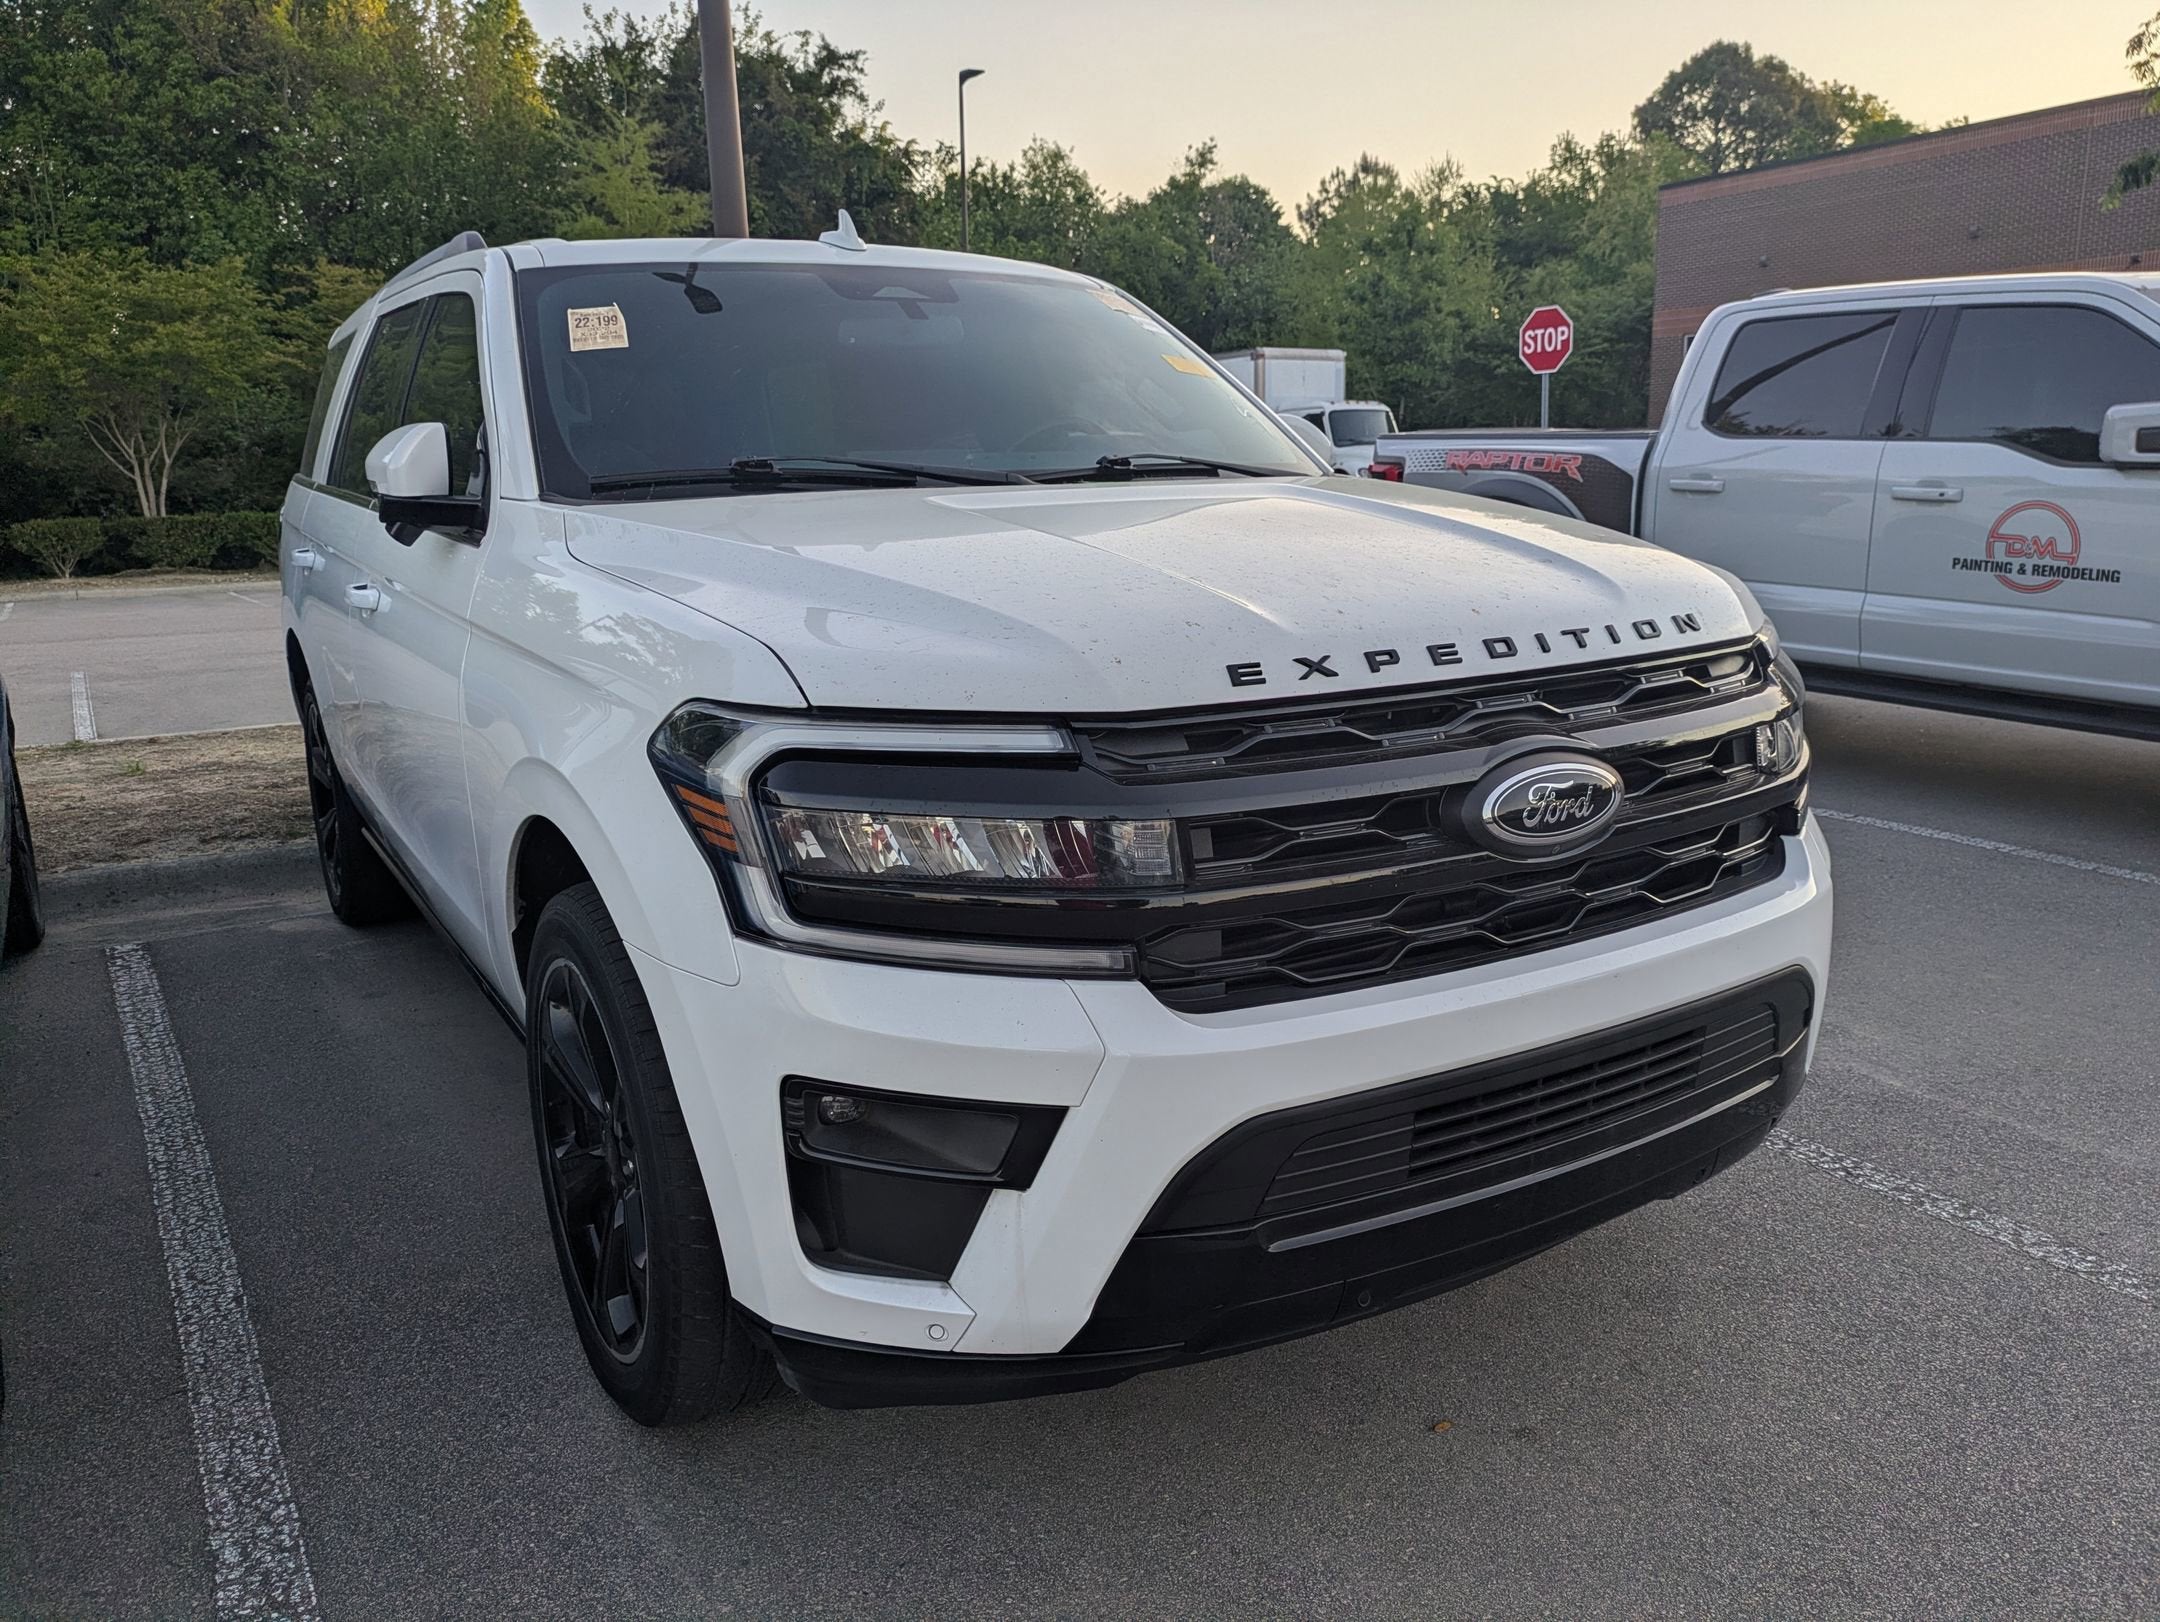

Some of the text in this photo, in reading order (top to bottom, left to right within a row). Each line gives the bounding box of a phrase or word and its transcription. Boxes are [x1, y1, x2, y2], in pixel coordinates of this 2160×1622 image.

[1523, 325, 1569, 354] STOP
[1446, 450, 1583, 482] RAPTOR
[1952, 557, 2121, 584] PAINTING & REMODELING
[1225, 612, 1703, 687] EXPEDITION
[1522, 779, 1594, 828] Ford
